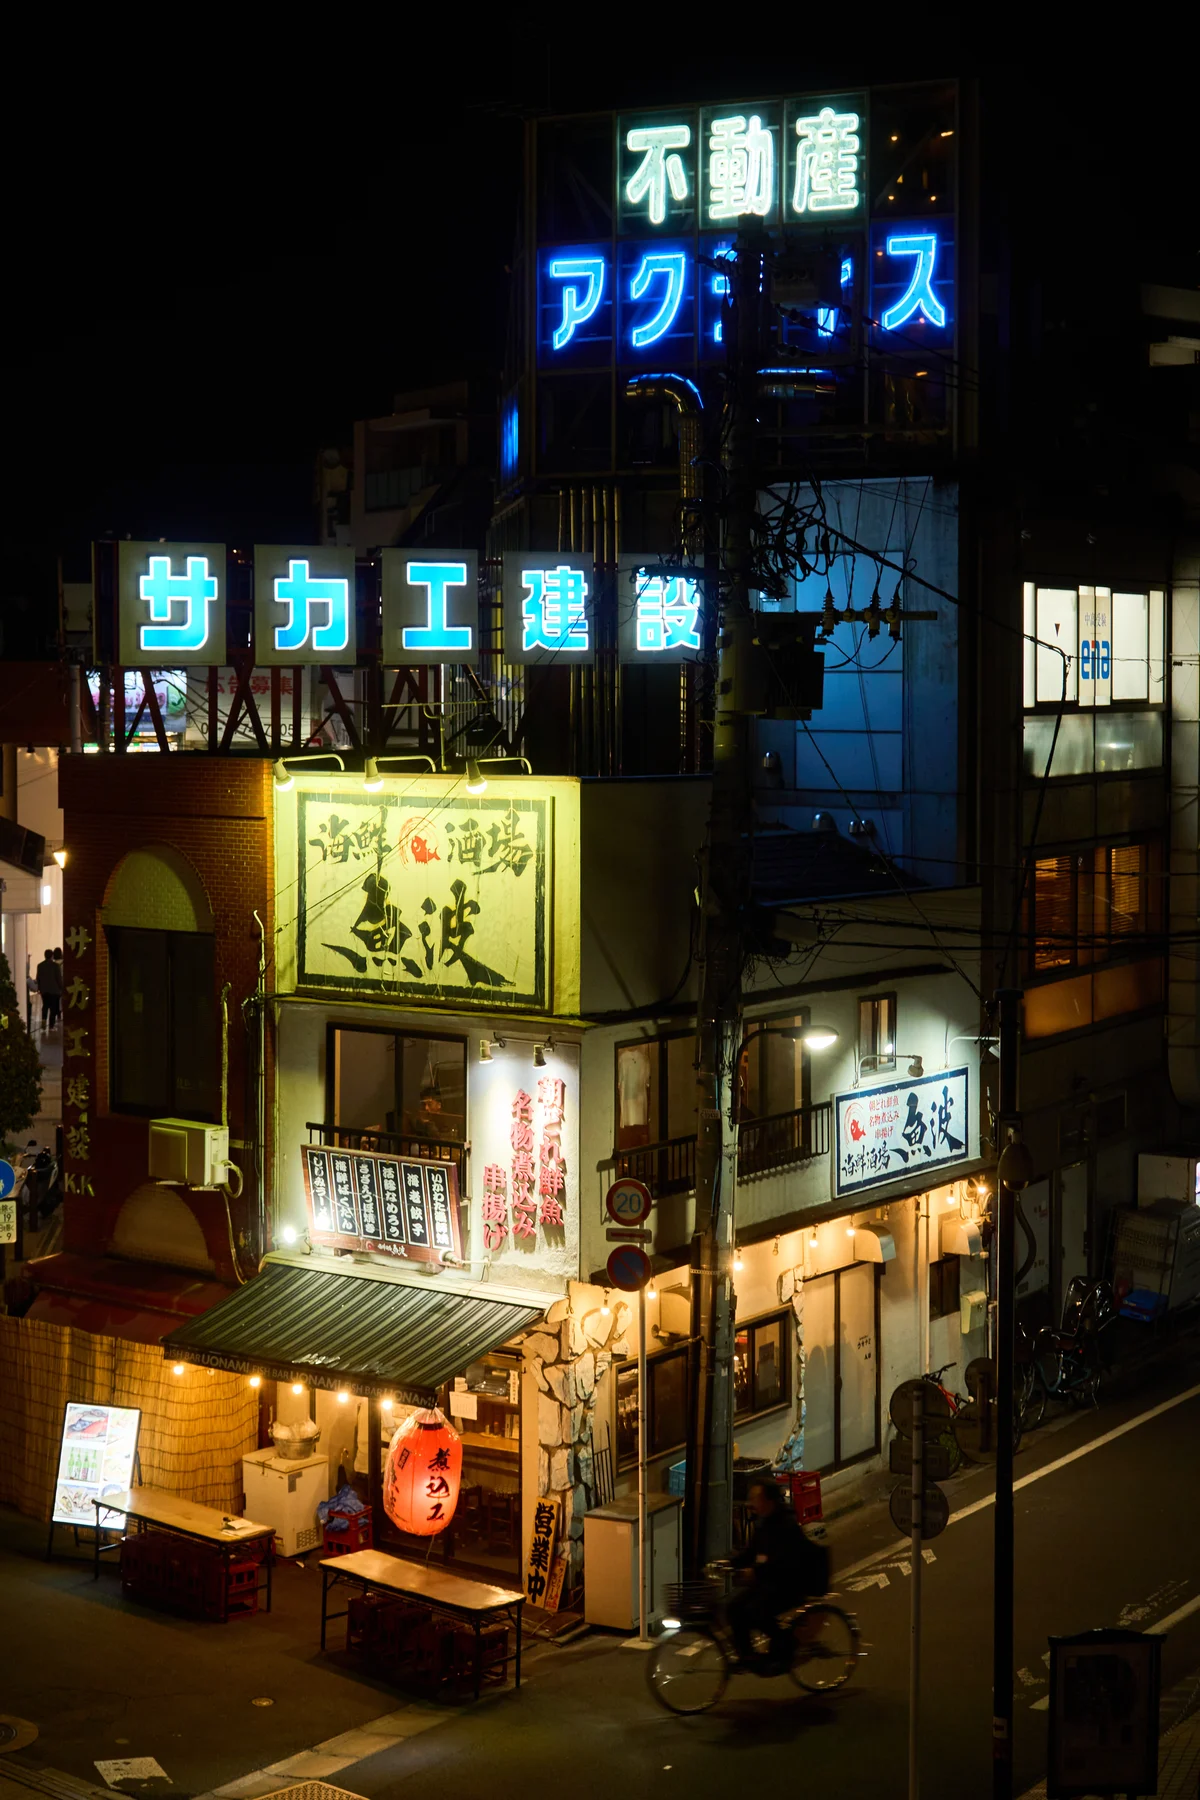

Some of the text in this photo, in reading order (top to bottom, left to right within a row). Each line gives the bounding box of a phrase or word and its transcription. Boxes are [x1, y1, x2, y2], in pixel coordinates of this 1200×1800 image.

[624, 105, 862, 226] 不動産
[1081, 640, 1110, 680] ena
[308, 806, 536, 878] 海鮮 酒場
[320, 872, 517, 990] 魚波
[510, 1088, 537, 1240] 名物煮込み
[841, 1140, 891, 1180] 海鮮酒場
[889, 1085, 967, 1164] 魚波
[482, 1163, 509, 1252] 串揚げ
[616, 1192, 641, 1213] 20
[527, 1501, 556, 1604] 営業中
